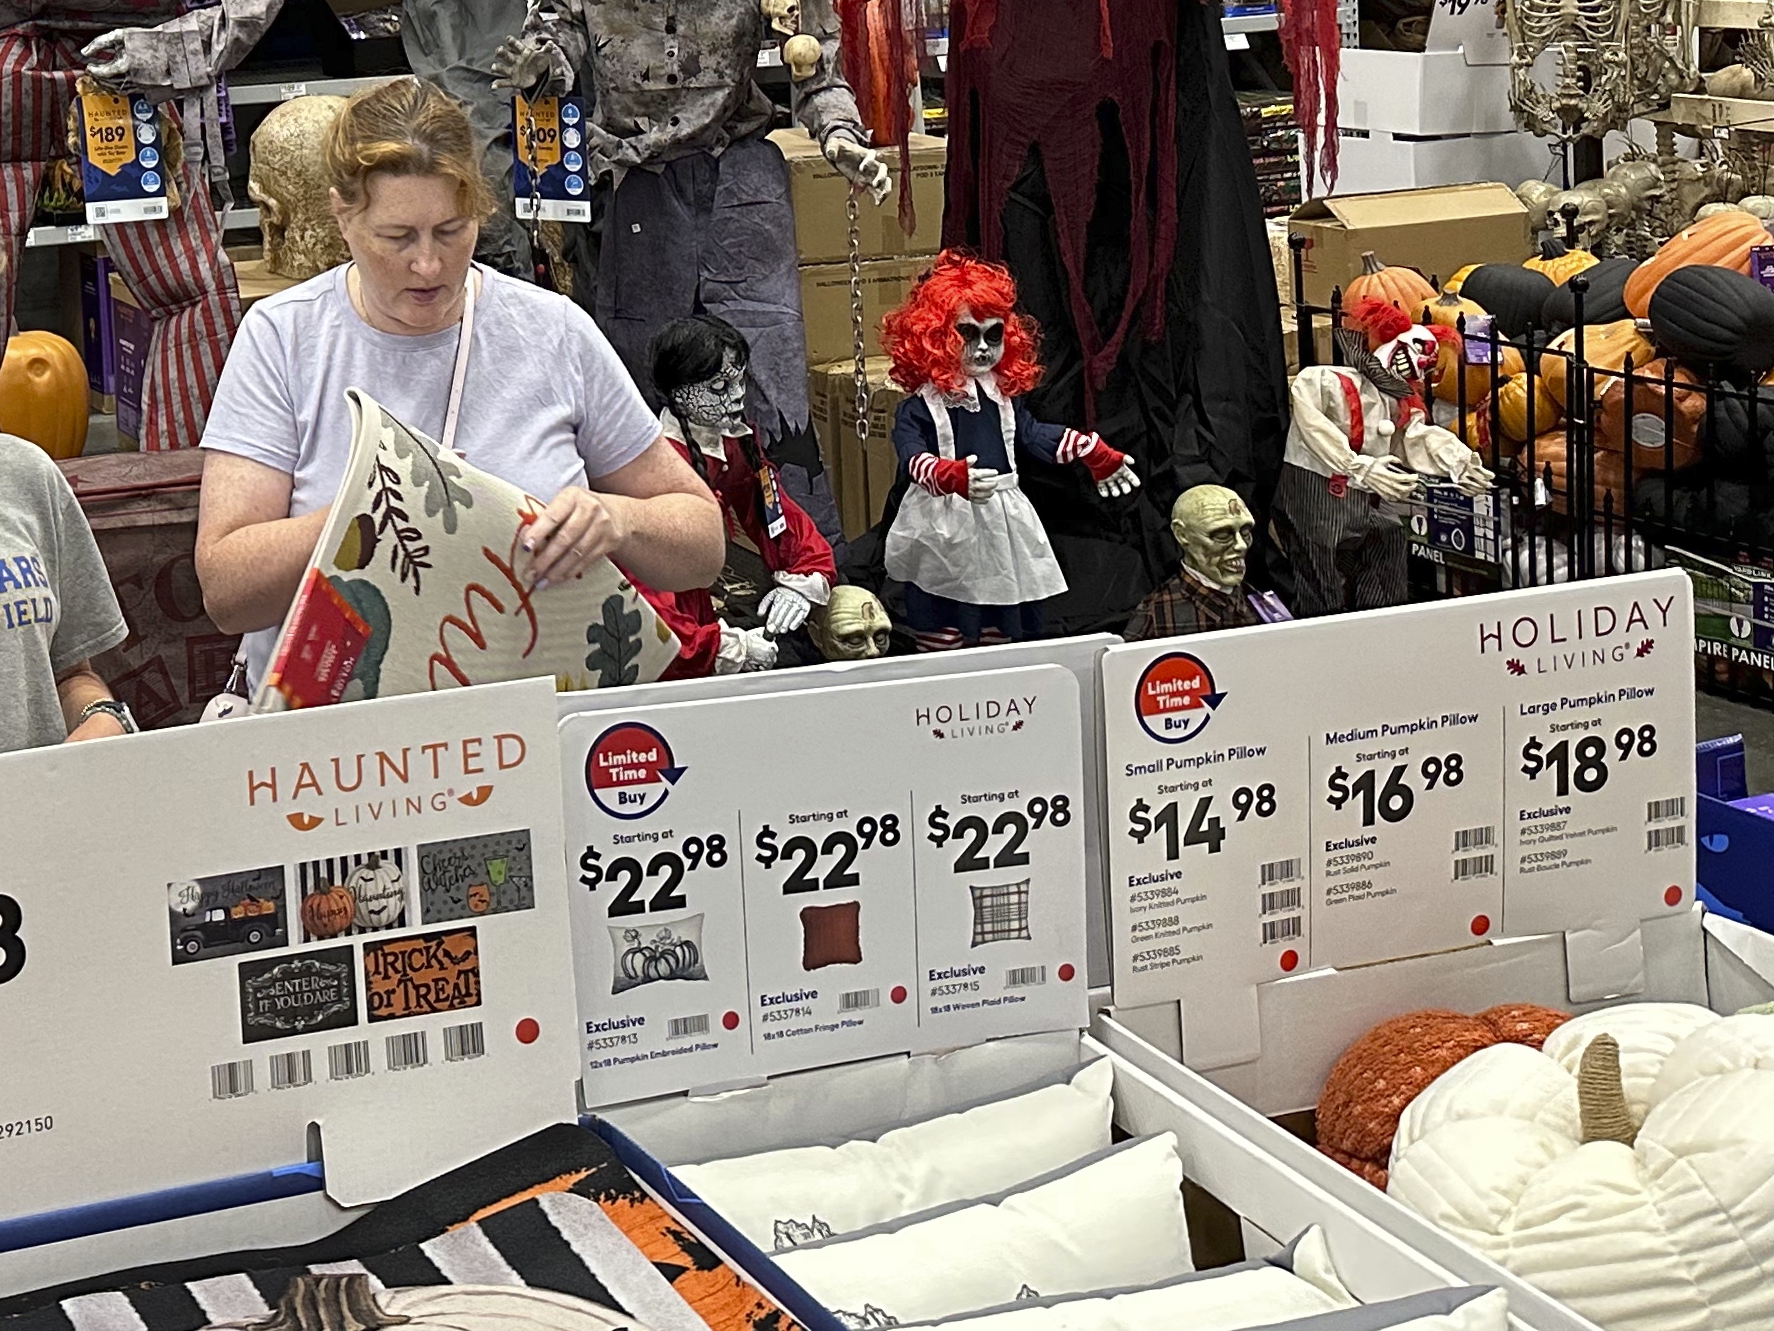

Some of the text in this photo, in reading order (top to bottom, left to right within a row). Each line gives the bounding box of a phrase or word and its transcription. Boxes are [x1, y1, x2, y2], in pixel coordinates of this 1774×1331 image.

[90, 126, 125, 143] $189
[1411, 543, 1445, 565] PANEL
[1480, 596, 1674, 654] HOLIDAY
[1537, 645, 1625, 674] LIVING
[1147, 676, 1200, 695] Limited
[1157, 694, 1191, 710] Time
[1520, 687, 1655, 716] Large Pumpkin Pillow
[916, 696, 1037, 726] HOLIDAY
[951, 722, 1006, 739] LIVING
[1164, 717, 1190, 731] Buy
[1326, 713, 1479, 745] Medium Pumpkin Pillow
[1549, 718, 1601, 733] Starting at
[599, 748, 657, 767] Limited
[1125, 746, 1267, 776] Small Pumpkin Pillow
[1356, 747, 1409, 762] Starting at
[248, 733, 526, 806] HAUNTED
[609, 768, 647, 782] Time
[1157, 778, 1213, 795] Starting at
[618, 791, 646, 806] Buy
[960, 789, 1019, 805] Starting at
[335, 790, 447, 827] LIVING
[789, 808, 848, 824] Starting at
[1519, 805, 1571, 821] Exclusive
[613, 829, 674, 845] Starting at
[1325, 834, 1377, 852] Exclusive
[1128, 869, 1183, 888] Exclusive
[368, 940, 444, 976] TRICK
[929, 964, 986, 981] Exclusive
[275, 976, 319, 995] ENTER
[398, 969, 478, 1011] TREAT
[259, 988, 338, 1013] IF YOU DARE
[760, 988, 818, 1007] Exclusive
[1003, 995, 1026, 1004] Pillow
[586, 1015, 645, 1034] Exclusive
[841, 1019, 864, 1028] Pillow
[695, 1043, 719, 1052] Pillow
